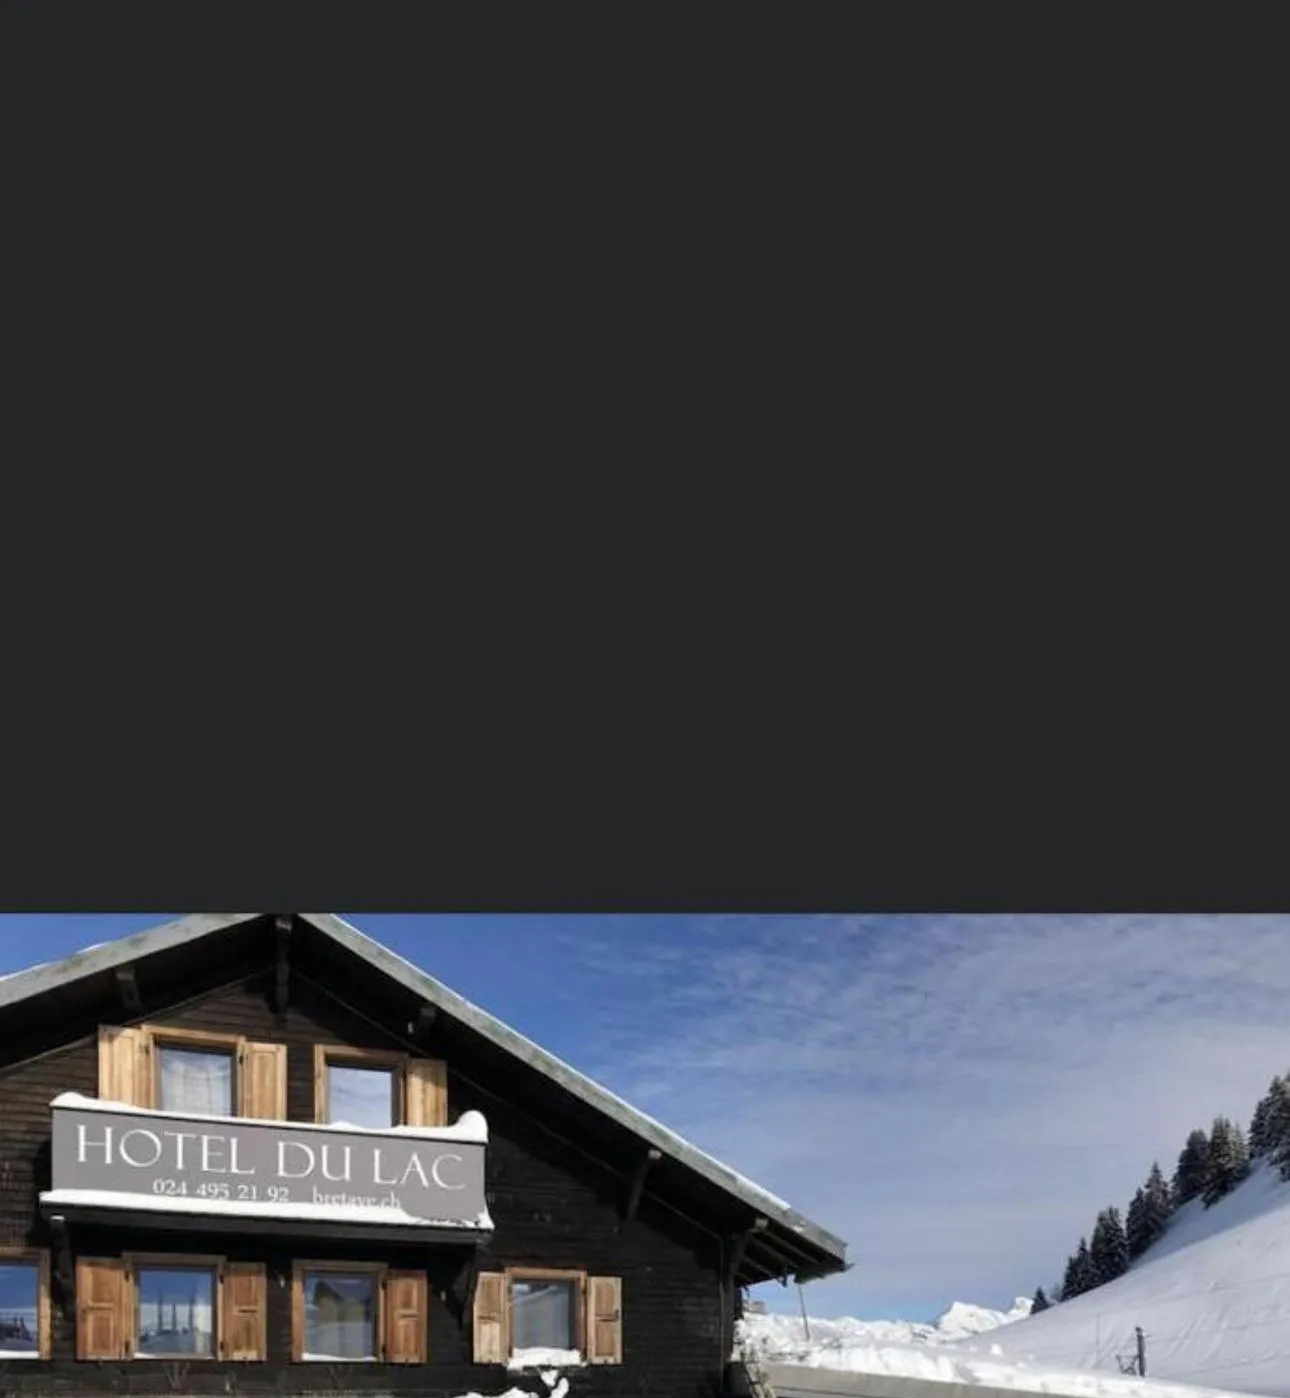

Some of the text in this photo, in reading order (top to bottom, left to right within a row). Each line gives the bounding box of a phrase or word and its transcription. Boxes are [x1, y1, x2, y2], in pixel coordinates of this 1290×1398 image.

[77, 1124, 467, 1191] HOTEL DU LAC
[152, 1179, 290, 1203] 024 495 21 92
